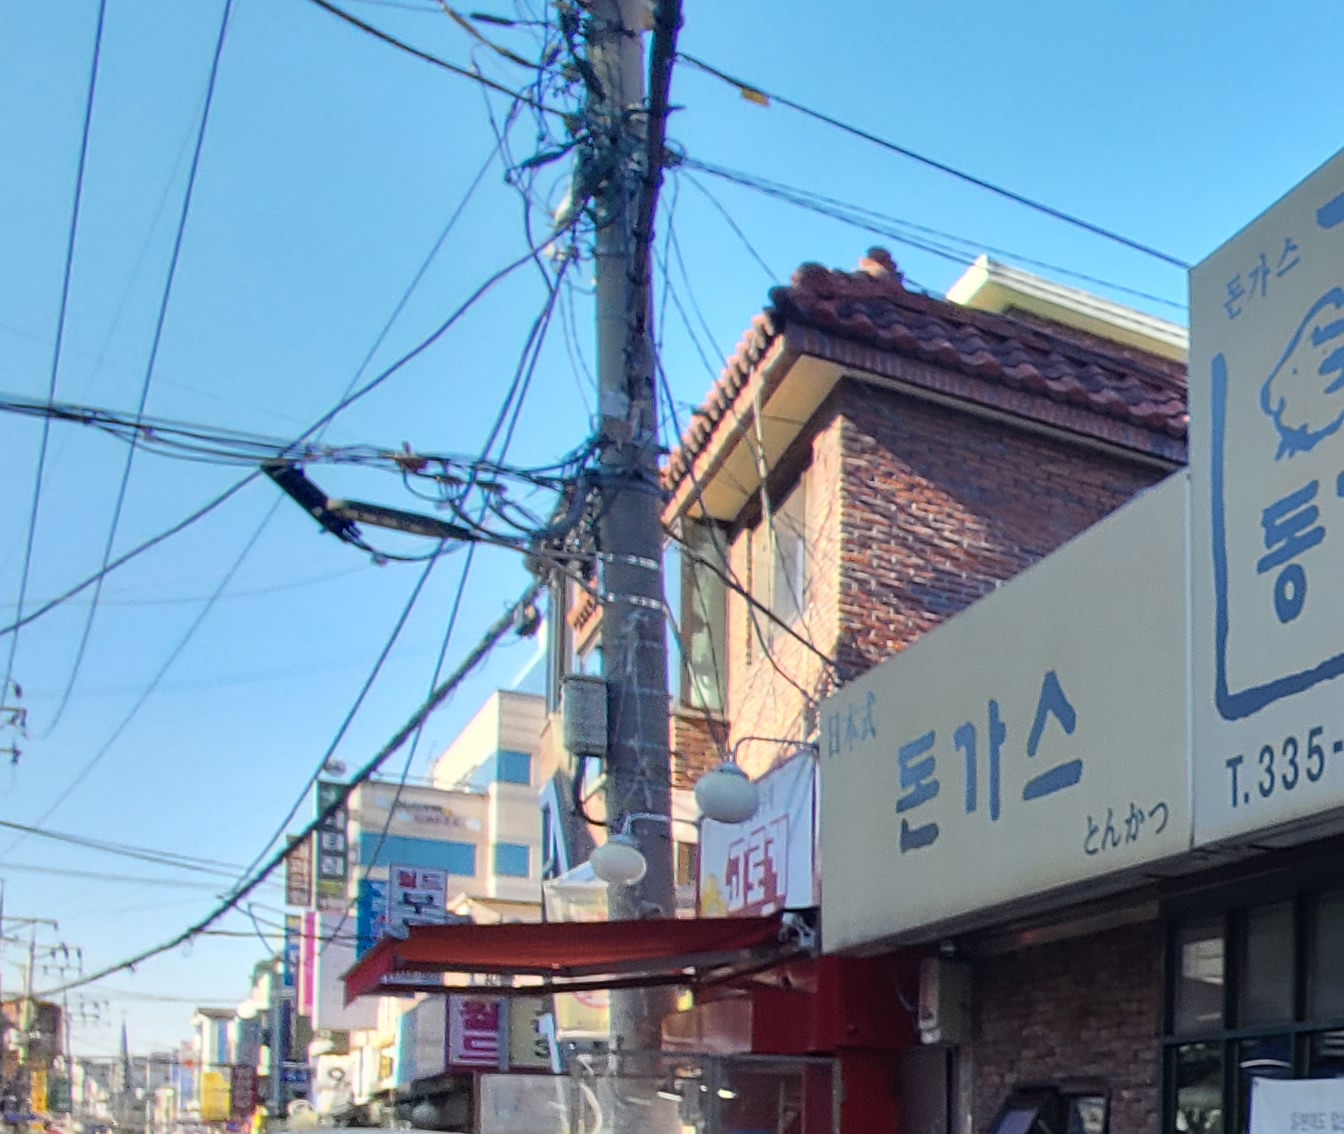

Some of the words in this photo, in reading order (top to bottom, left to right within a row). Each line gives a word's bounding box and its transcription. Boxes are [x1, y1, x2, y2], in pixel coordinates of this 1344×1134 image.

[1223, 237, 1300, 320] 돈가스
[827, 691, 878, 760] 日本式
[896, 670, 1083, 855] 돈가스
[1083, 800, 1169, 857] とんかつ
